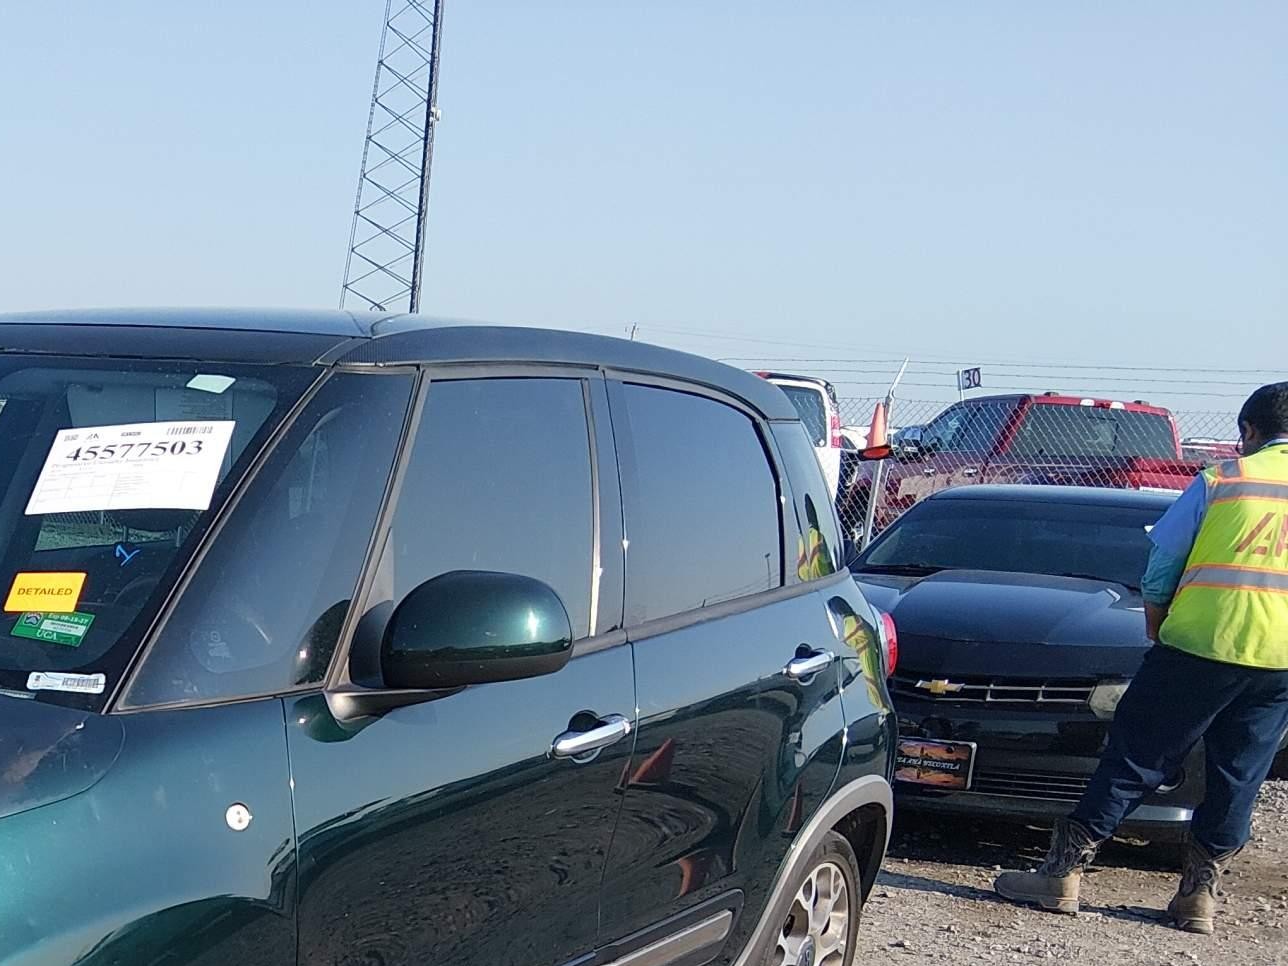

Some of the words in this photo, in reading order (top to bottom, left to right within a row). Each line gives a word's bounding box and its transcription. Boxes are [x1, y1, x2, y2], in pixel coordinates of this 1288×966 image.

[964, 368, 981, 389] 30
[66, 440, 204, 461] 45577503
[17, 587, 73, 596] DETAILED
